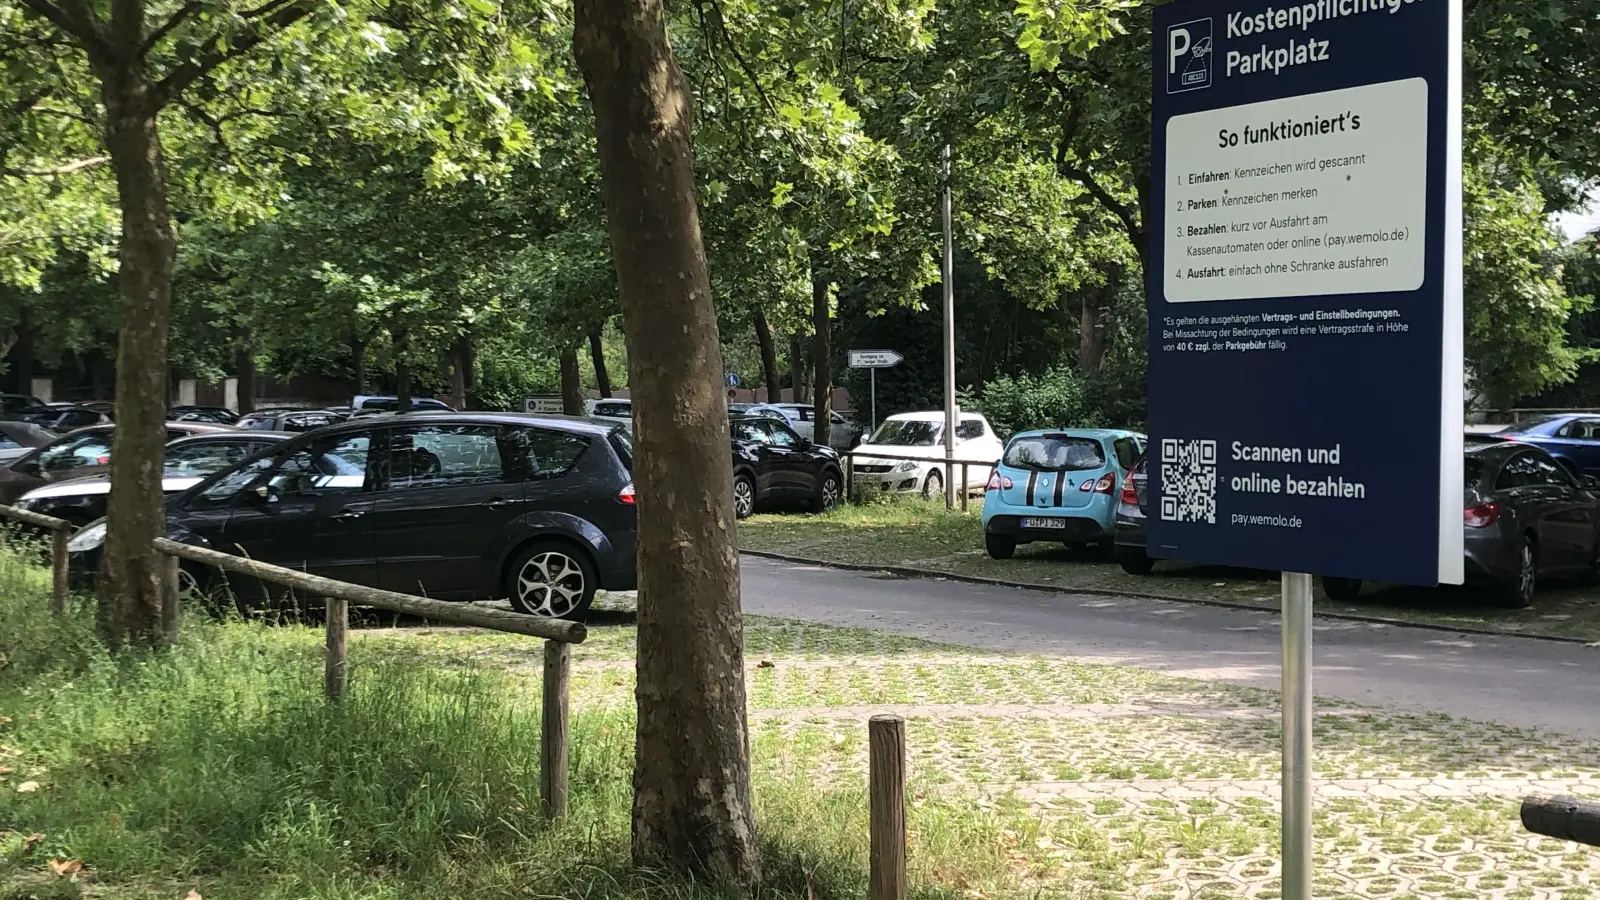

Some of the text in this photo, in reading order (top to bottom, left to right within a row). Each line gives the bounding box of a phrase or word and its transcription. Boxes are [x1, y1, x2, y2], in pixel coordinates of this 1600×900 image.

[1226, 0, 1423, 39] Kostenpflichg
[1170, 28, 1190, 74] P
[1226, 37, 1330, 77] Parkplatz
[1218, 129, 1239, 148] So
[1177, 153, 1366, 186] 1. Einfahren: Kennzeichen wird gescannt
[1177, 187, 1318, 212] 2. Parken: Kennzeichen merken
[1176, 214, 1328, 238] 3. Bezahlen: kurz vor Ausfahrt am
[1187, 226, 1409, 257] Kassenautomaten oder online (pay.wemolo.de)
[1176, 255, 1388, 280] 4. Ausfahrt: einfach ohne Schranke ausfahren
[1176, 316, 1197, 327] gelten
[1198, 315, 1209, 325] die
[1210, 313, 1260, 326] ausgehängten
[1261, 312, 1297, 324] Vertrags-
[1299, 311, 1314, 321] und
[1316, 309, 1401, 323] Einstellbedingungen.
[1163, 322, 1409, 340] Bei Missachtung der Bedingungen wird eine Vertragsstrafe in Höhe
[1163, 340, 1288, 353] von 40 € zzgl. der Parkgebühr fällig.
[1231, 441, 1341, 465] Scannen und
[1231, 473, 1366, 499] online bezahlen
[1040, 518, 1049, 527] PI
[1050, 519, 1065, 528] 329
[1231, 512, 1303, 528] pay.wemolo.de
